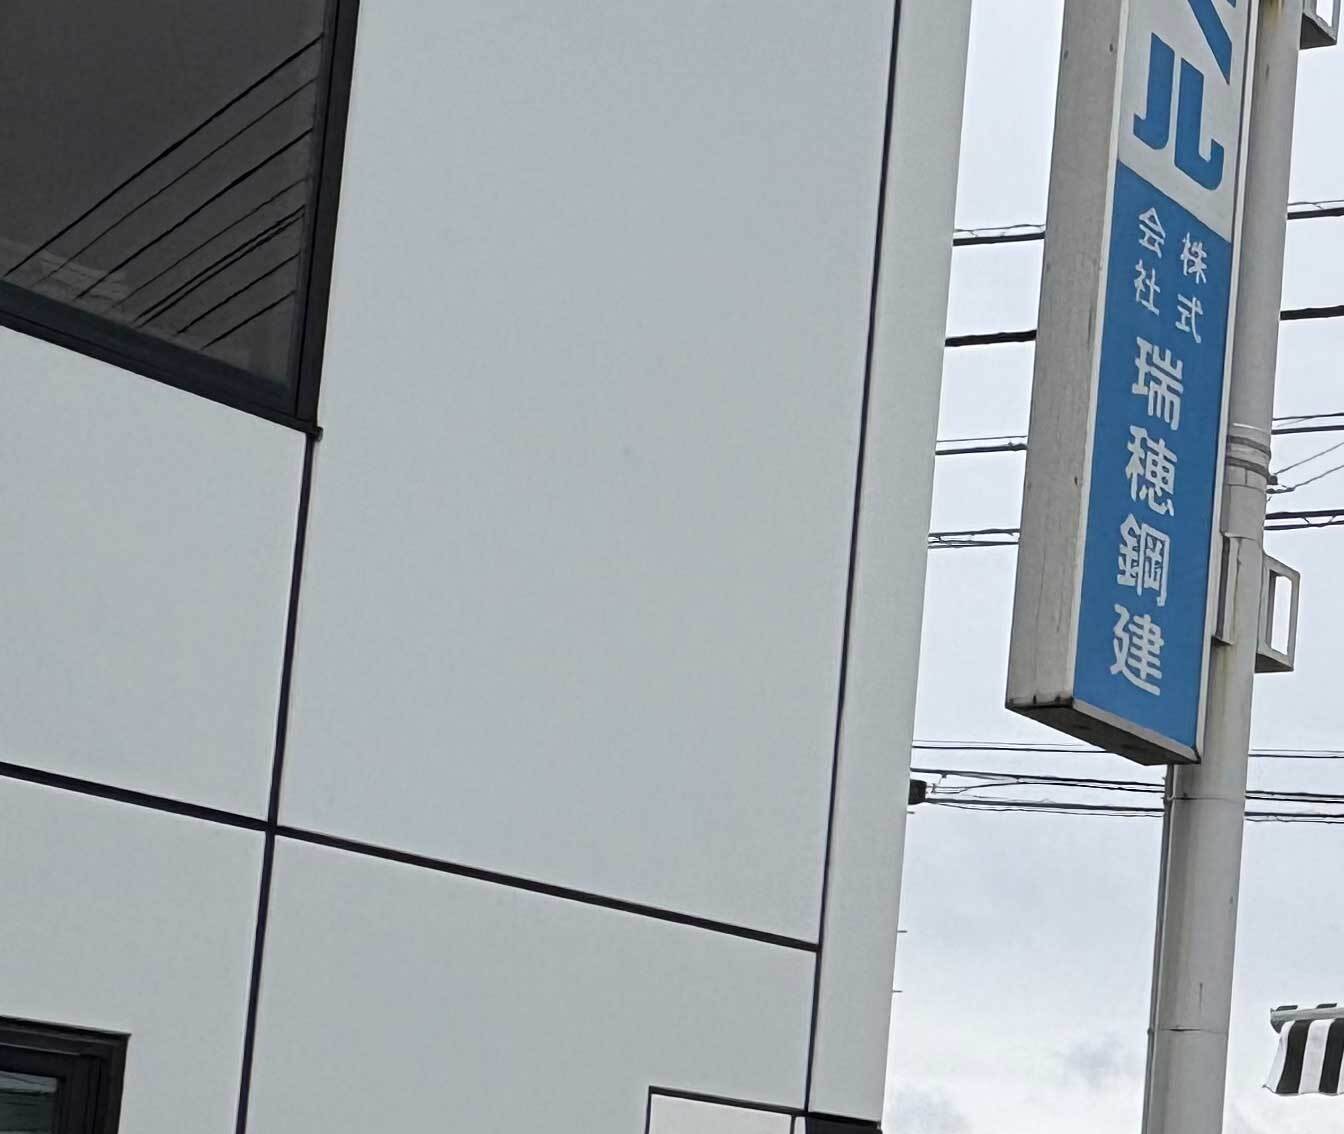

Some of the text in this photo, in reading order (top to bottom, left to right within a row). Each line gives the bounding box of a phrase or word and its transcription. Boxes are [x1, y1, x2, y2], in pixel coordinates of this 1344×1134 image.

[1133, 207, 1166, 316] 会社
[1174, 231, 1208, 344] 株式
[1108, 335, 1185, 696] 瑞穂鋼建
